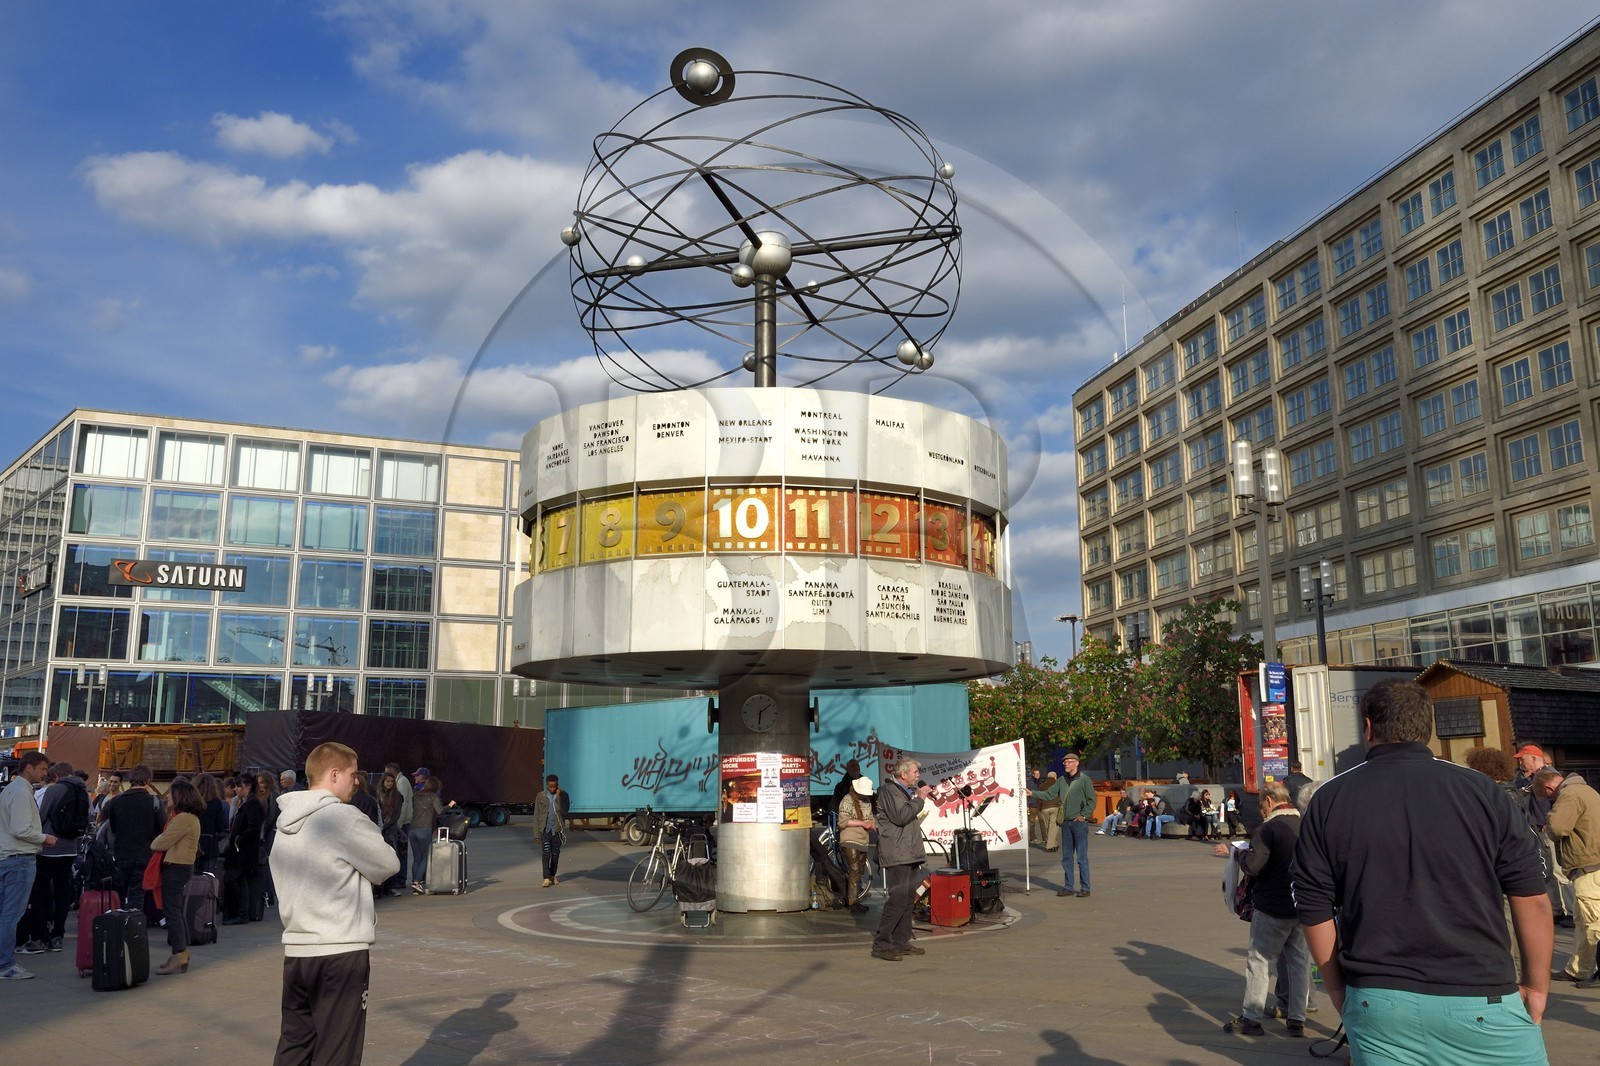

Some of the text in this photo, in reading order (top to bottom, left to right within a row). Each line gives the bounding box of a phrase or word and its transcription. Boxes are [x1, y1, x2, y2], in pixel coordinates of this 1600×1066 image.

[800, 411, 842, 420] MONTREAL
[589, 420, 624, 431] VANCOUVER
[652, 421, 690, 430] EDMONTON
[876, 419, 904, 429] HALIFAX
[594, 429, 619, 439] DAWSON
[656, 430, 684, 438] DENVER
[794, 428, 848, 436] WASHINGTON
[584, 436, 630, 450] SAN FRANCISCO
[600, 445, 624, 454] ANGELES
[802, 454, 840, 462] HAVANNA
[656, 501, 686, 542] 9
[712, 498, 768, 538] 10
[788, 498, 830, 539] 11
[859, 502, 900, 544] 12
[598, 507, 622, 548] 8
[915, 511, 950, 551] 13
[557, 514, 575, 555] 7
[157, 564, 243, 588] SATURN
[877, 584, 908, 594] CARACAS
[938, 582, 962, 591] BRASILIA
[876, 602, 910, 611] ASUNCIÓN
[714, 615, 760, 624] GALÁPAGOS
